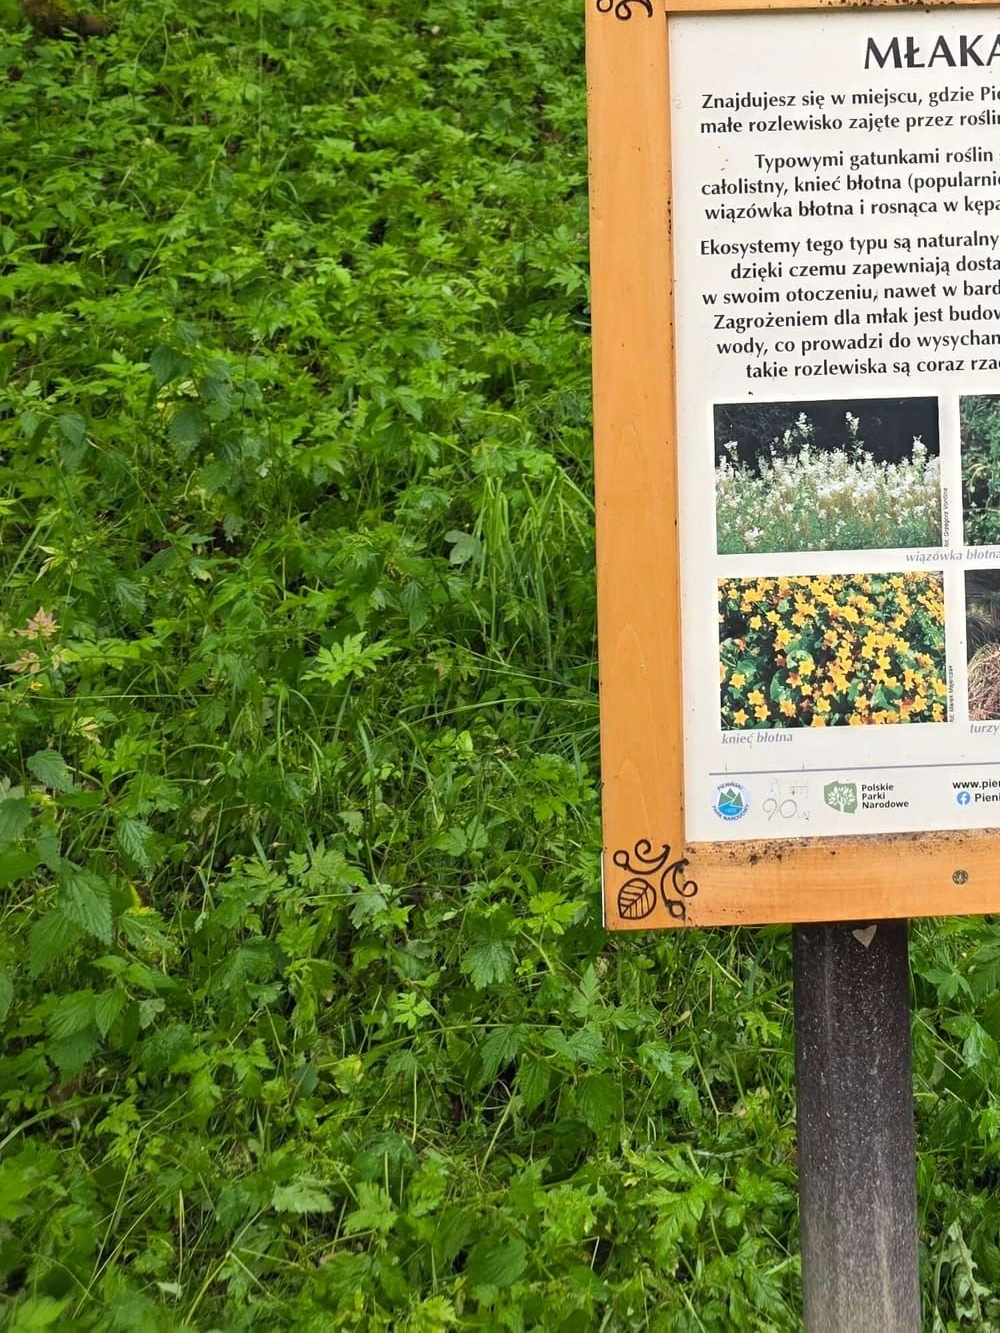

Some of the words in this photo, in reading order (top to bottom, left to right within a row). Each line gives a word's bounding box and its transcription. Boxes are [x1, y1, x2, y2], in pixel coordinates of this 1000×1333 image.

[702, 92, 795, 111] Znajdujesz
[802, 91, 824, 109] się
[831, 95, 845, 104] w
[853, 89, 922, 107] miejscu,
[929, 86, 974, 107] gdzie
[701, 117, 742, 133] małe
[749, 114, 842, 131] rozlewisko
[849, 113, 899, 132] zajęte
[907, 116, 953, 132] przez
[755, 151, 843, 173] Typowymi
[850, 148, 939, 170] gatunkami
[947, 147, 993, 162] roślin
[702, 178, 787, 197] całolistny,
[795, 176, 840, 192] knieć
[847, 175, 901, 190] błotna
[705, 202, 792, 223] wiązówka
[799, 201, 853, 216] błotna
[861, 199, 864, 214] i
[872, 202, 937, 217] rosnąca
[944, 202, 958, 212] w
[701, 239, 800, 258] Ekosystemy
[807, 238, 843, 255] tego
[850, 237, 887, 255] typu
[894, 238, 910, 252] są
[731, 262, 782, 282] dzięki
[789, 265, 845, 277] czemu
[853, 257, 949, 279] zapewniają
[703, 294, 717, 304] w
[724, 288, 779, 304] swoim
[786, 284, 877, 301] otoczeniu,
[884, 284, 936, 298] nawet
[943, 286, 957, 296] w
[714, 311, 827, 333] Zagrożeniem
[835, 309, 860, 325] dla
[867, 307, 908, 324] młak
[914, 307, 942, 326] jest
[717, 337, 767, 357] wody,
[775, 341, 795, 352] co
[802, 333, 882, 356] prowadzi
[889, 332, 910, 348] do
[746, 362, 787, 378] takie
[795, 358, 886, 376] rozlewiska
[893, 362, 910, 376] są
[917, 360, 964, 372] coraz
[906, 550, 962, 563] wiązówka
[722, 733, 752, 744] knieć
[757, 732, 792, 742] błotna
[862, 783, 893, 791] Polskie
[862, 792, 885, 800] Parki
[863, 800, 908, 808] Narodowe
